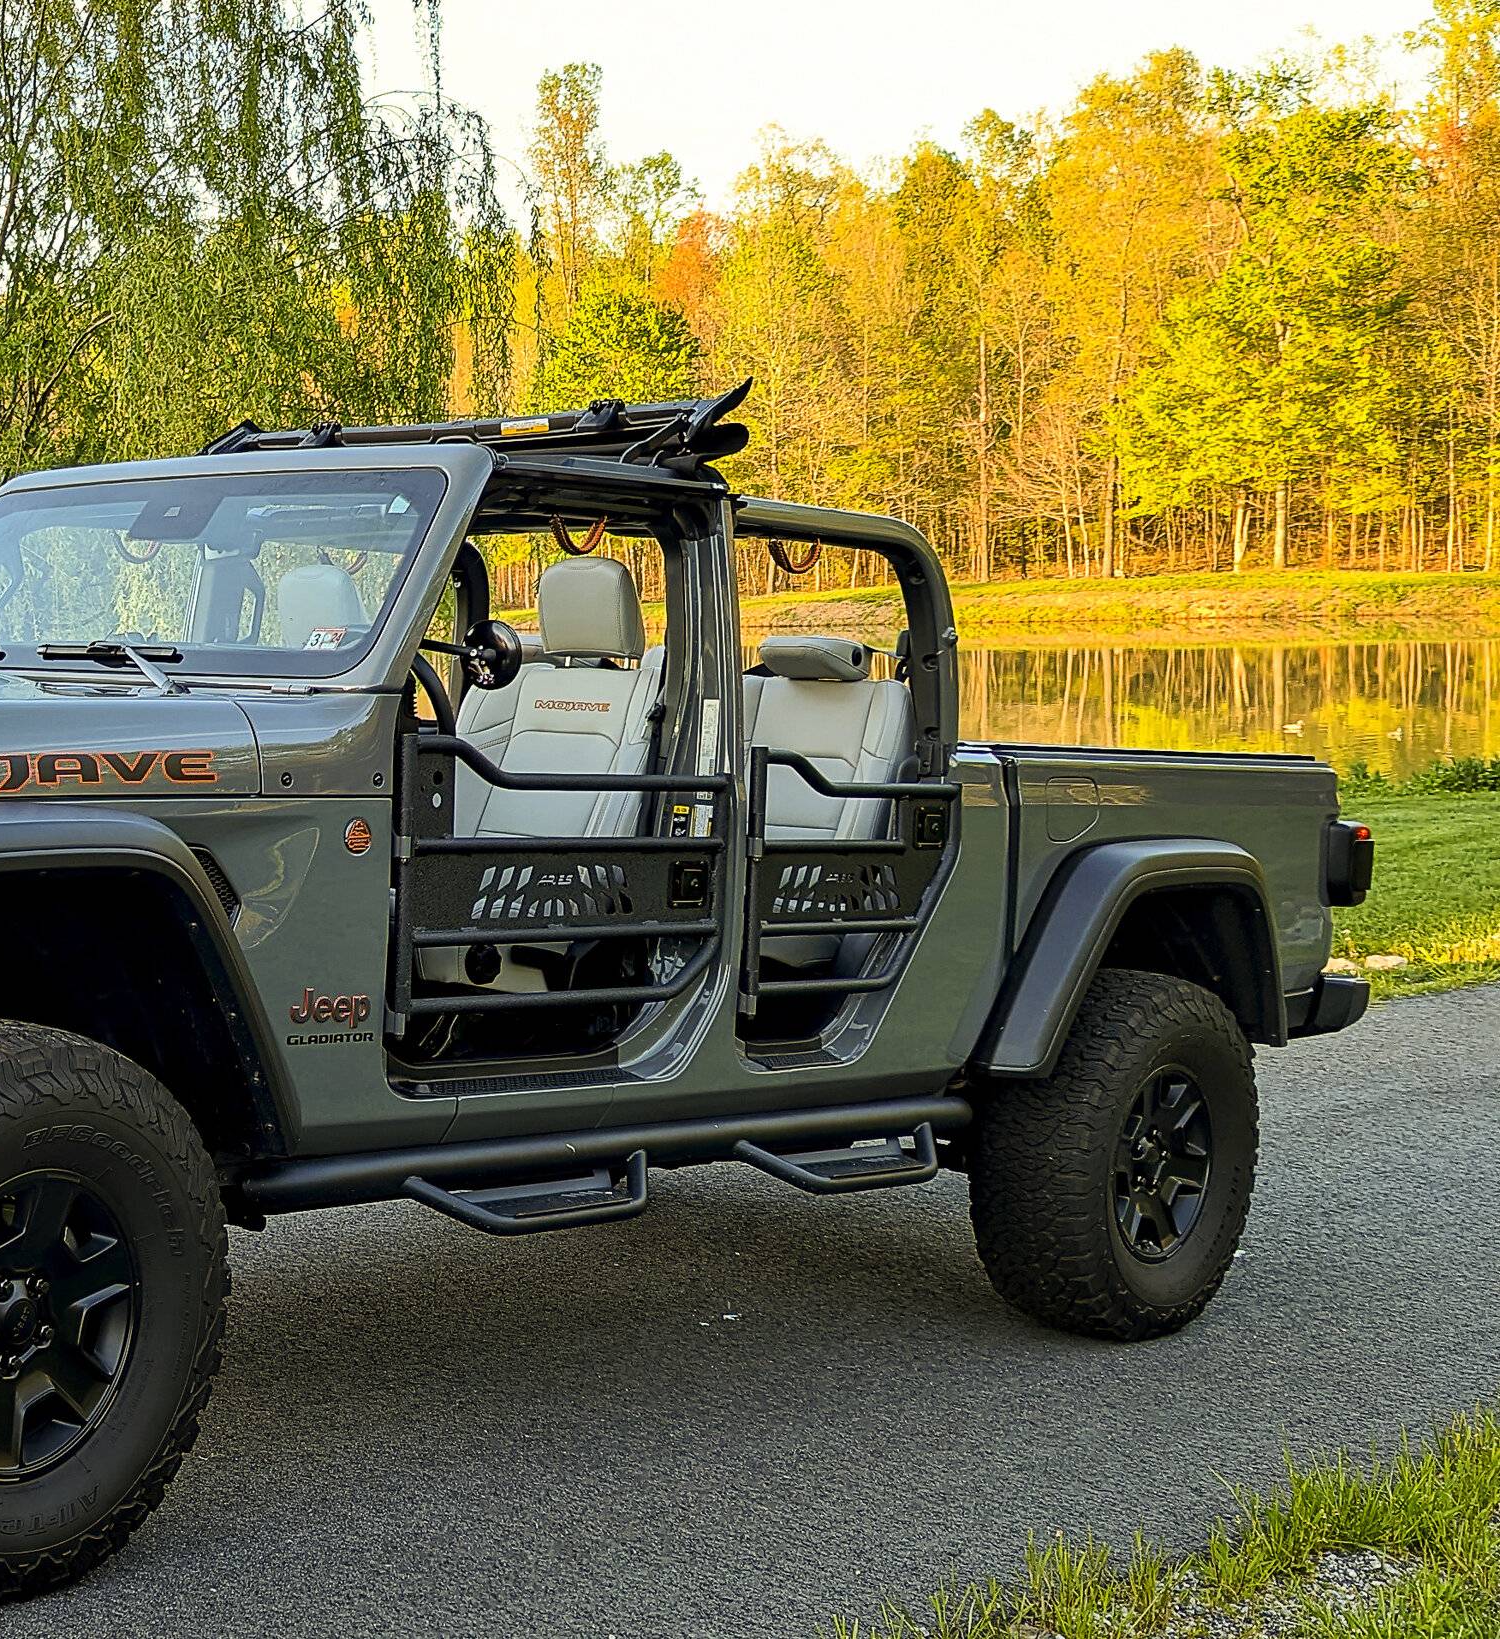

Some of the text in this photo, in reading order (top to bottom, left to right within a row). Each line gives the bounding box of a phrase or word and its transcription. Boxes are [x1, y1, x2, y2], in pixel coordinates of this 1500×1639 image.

[310, 633, 321, 647] 3
[534, 699, 611, 713] MOJAVE
[289, 987, 372, 1030] Jeep
[286, 1032, 374, 1046] GLADIATOR
